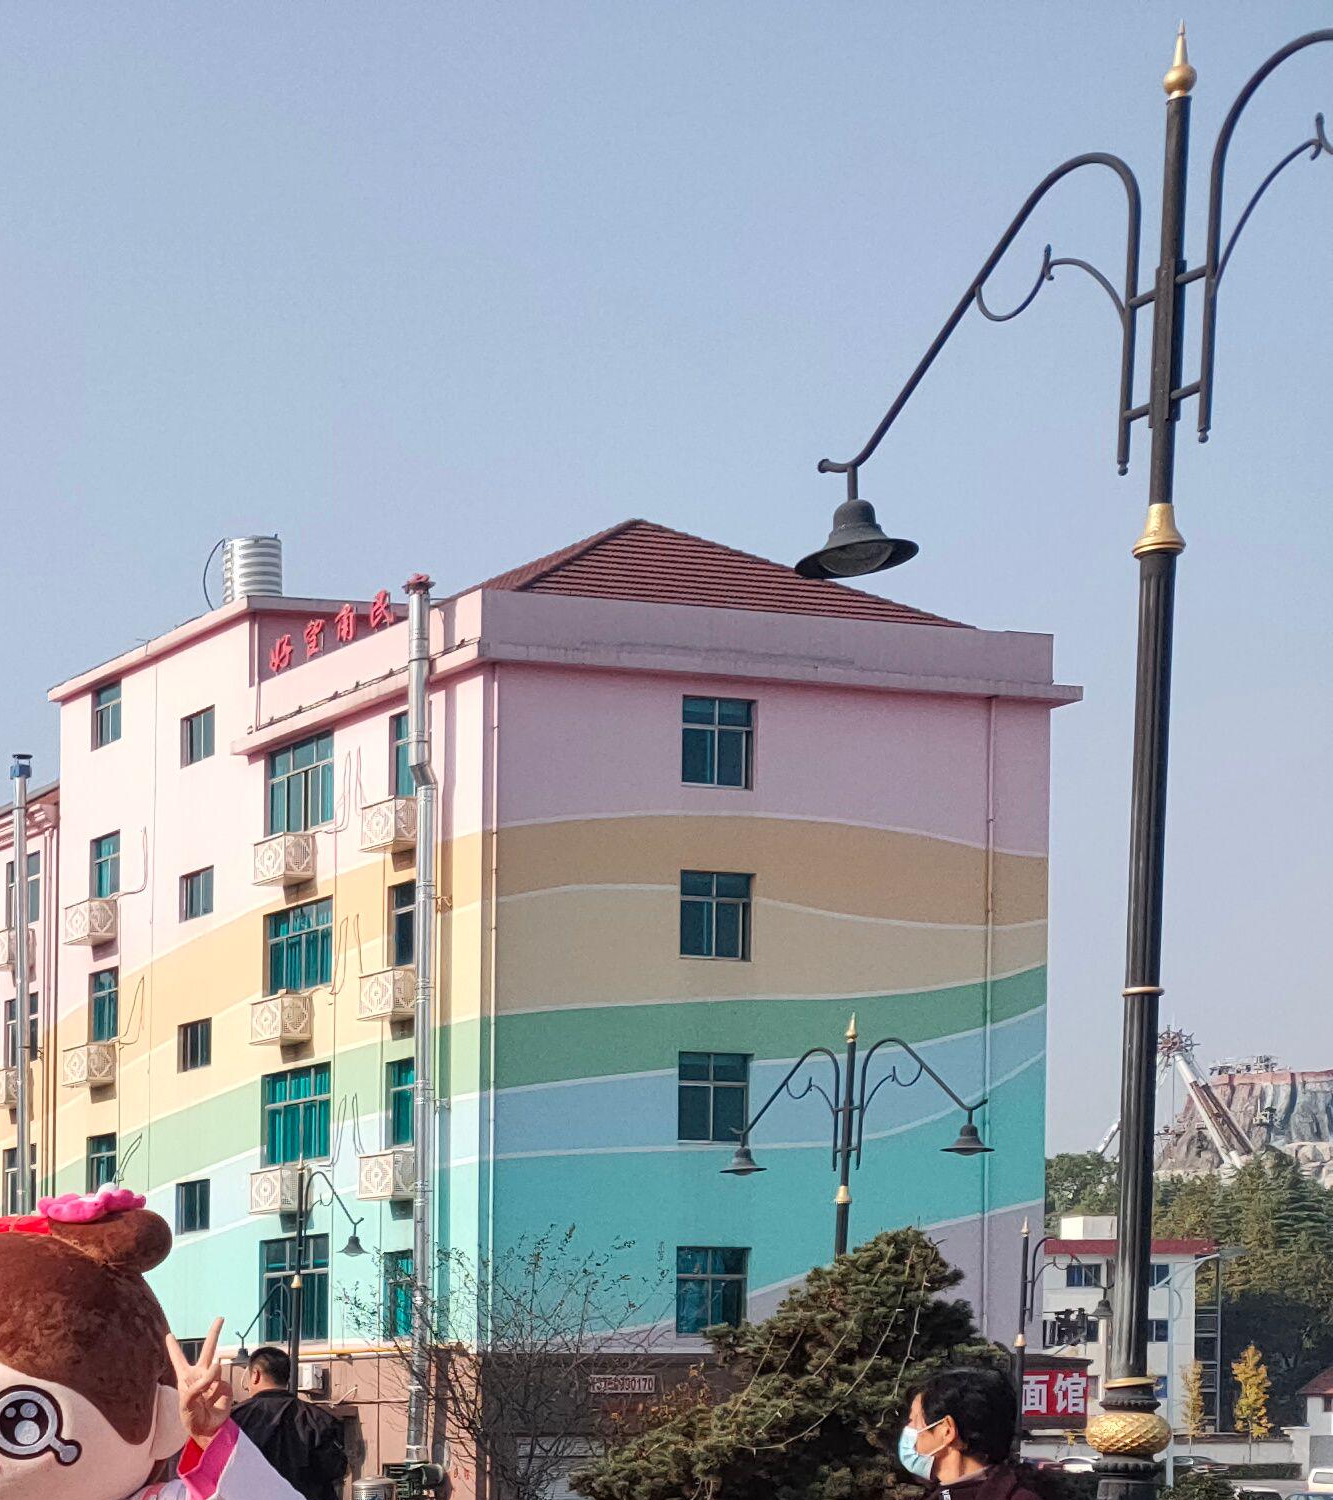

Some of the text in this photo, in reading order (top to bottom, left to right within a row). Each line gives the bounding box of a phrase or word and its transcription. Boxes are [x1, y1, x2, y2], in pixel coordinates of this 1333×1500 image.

[269, 574, 430, 672] 好望角民
[1022, 1373, 1087, 1414] 面馆
